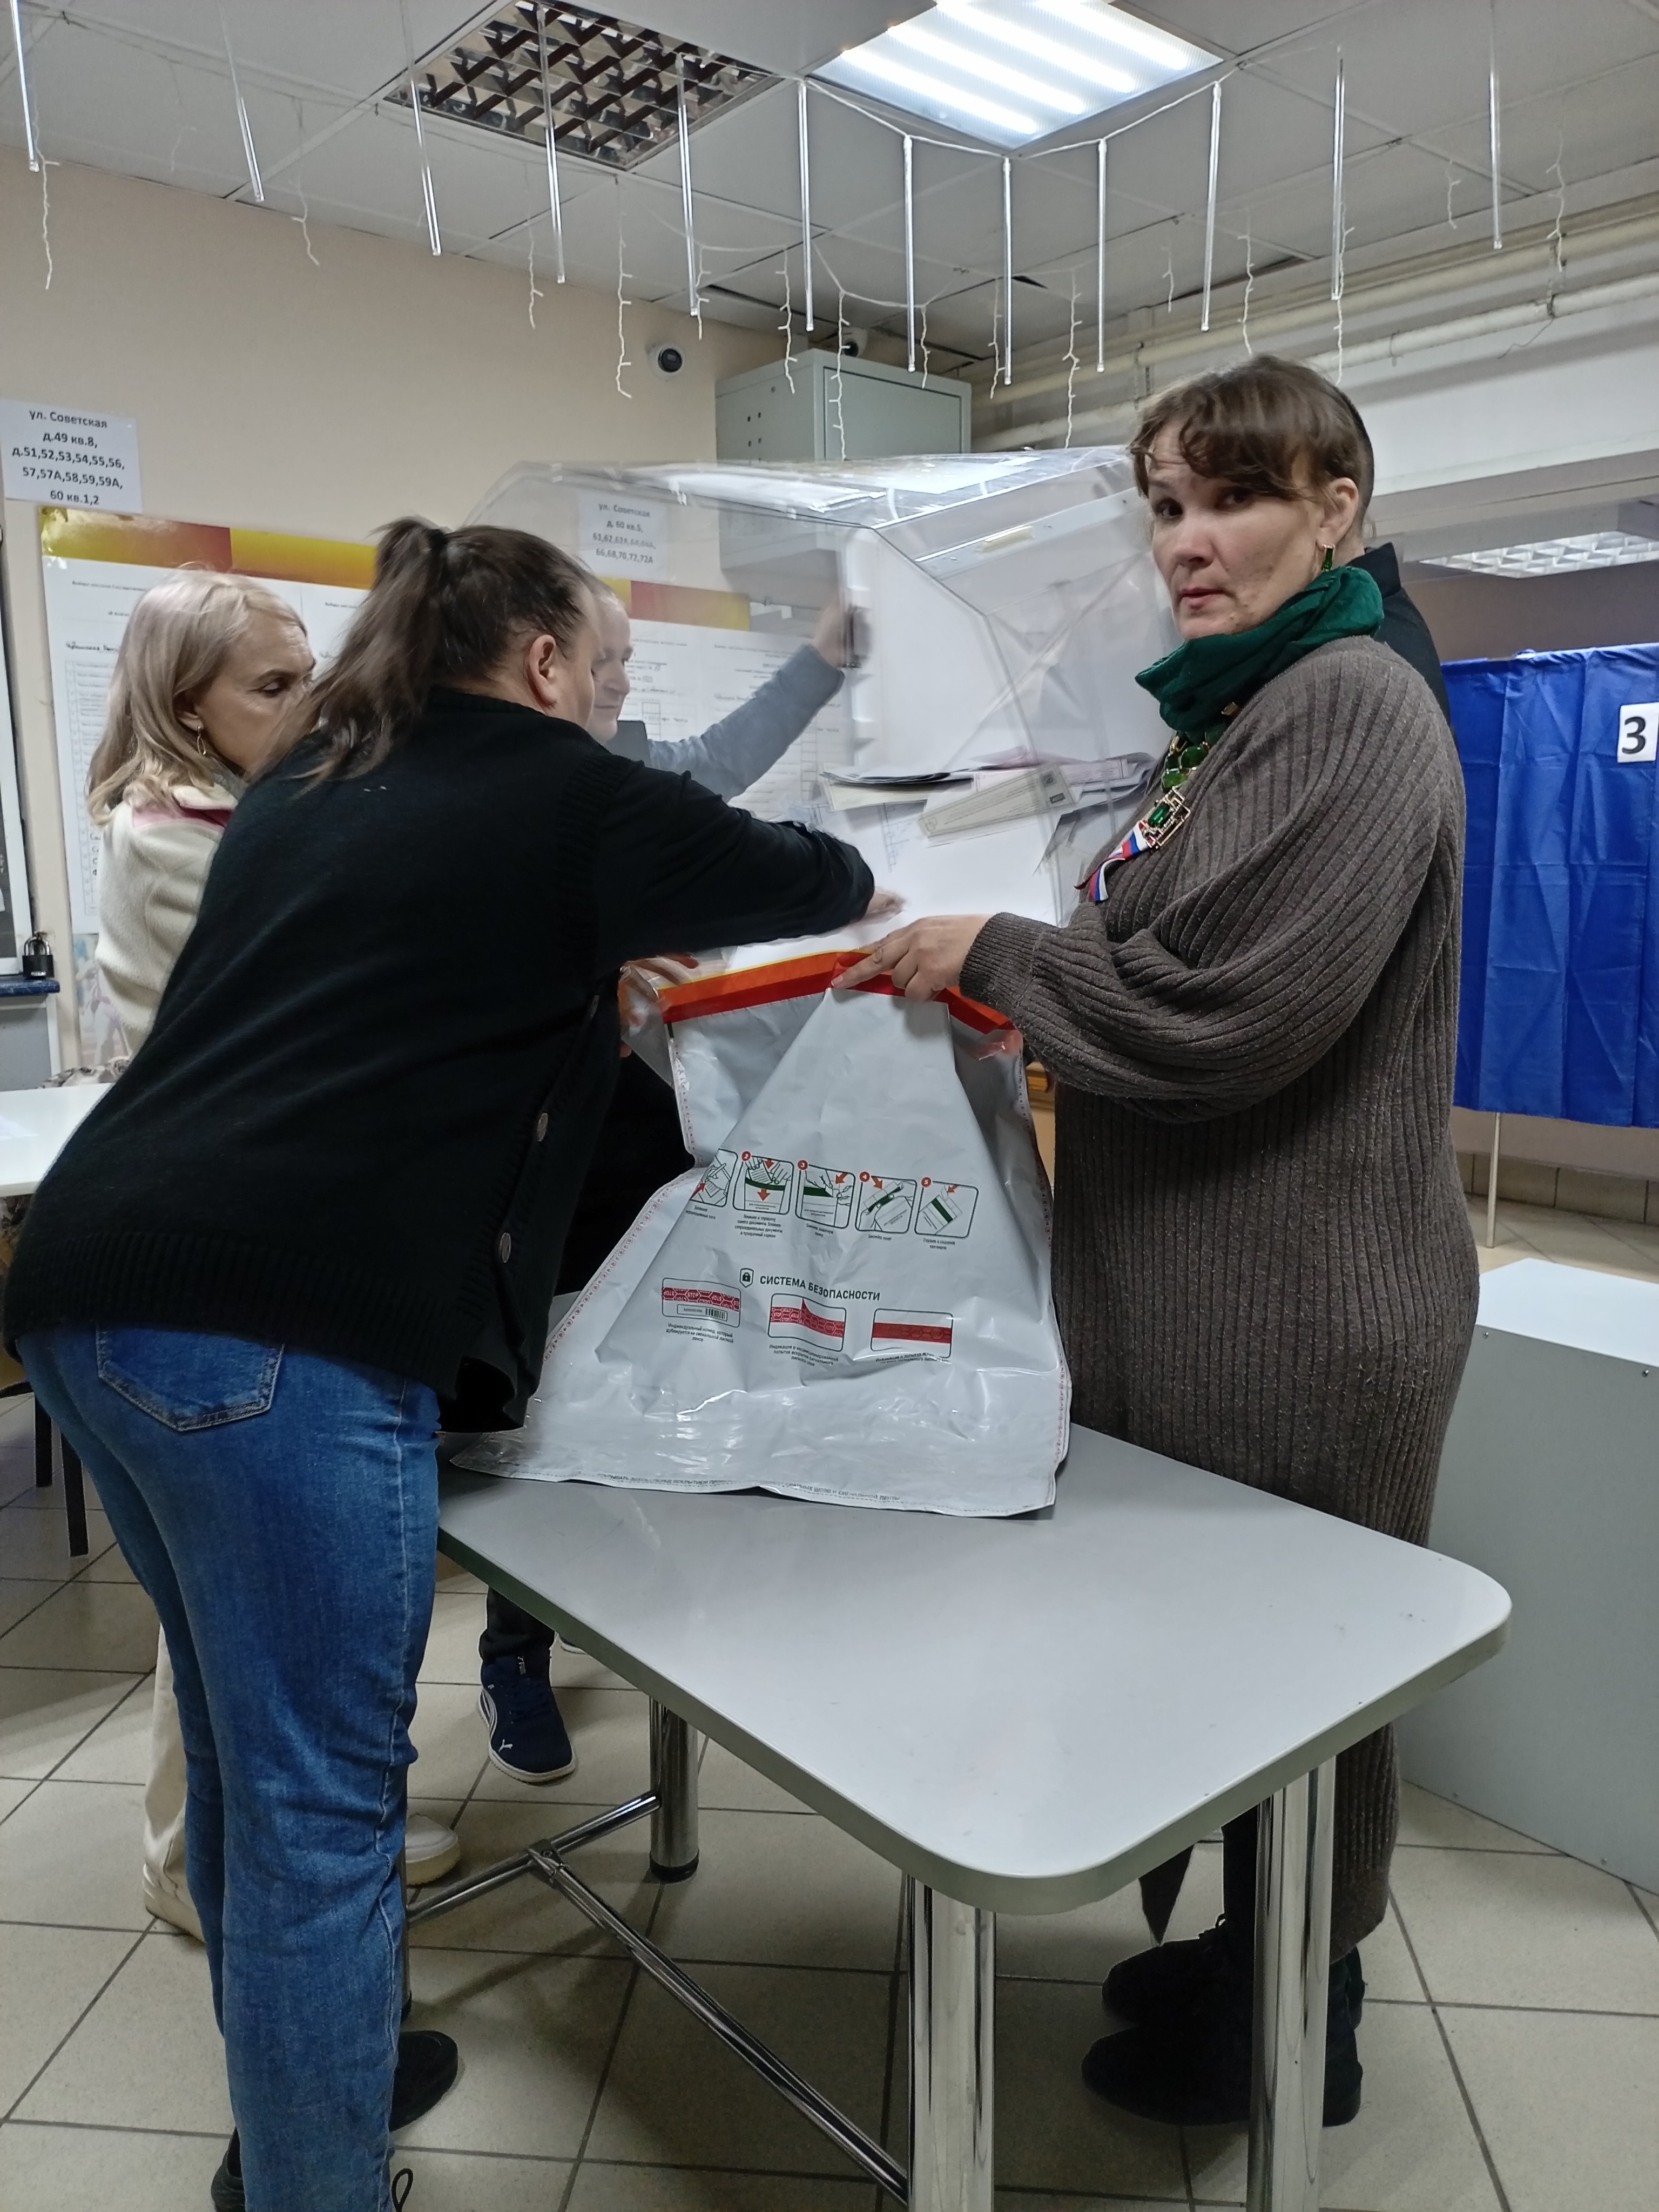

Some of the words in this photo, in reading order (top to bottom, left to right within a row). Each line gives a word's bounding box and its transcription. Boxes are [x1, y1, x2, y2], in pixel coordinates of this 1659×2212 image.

[29, 410, 46, 420] ул.
[50, 412, 107, 428] Советская
[43, 433, 68, 442] д.49
[71, 436, 98, 448] кв.8,
[12, 447, 125, 470] д.51,52,53,54,55,56,
[23, 466, 123, 489] 57,57А,58,59,59А,
[50, 490, 64, 500] 60
[67, 494, 99, 505] кв.1,2
[613, 505, 650, 517] Советская
[1622, 716, 1646, 754] 3
[760, 1276, 806, 1289] СИСТЕМА
[808, 1282, 880, 1301] БЕЗОПАСНОСТИ
